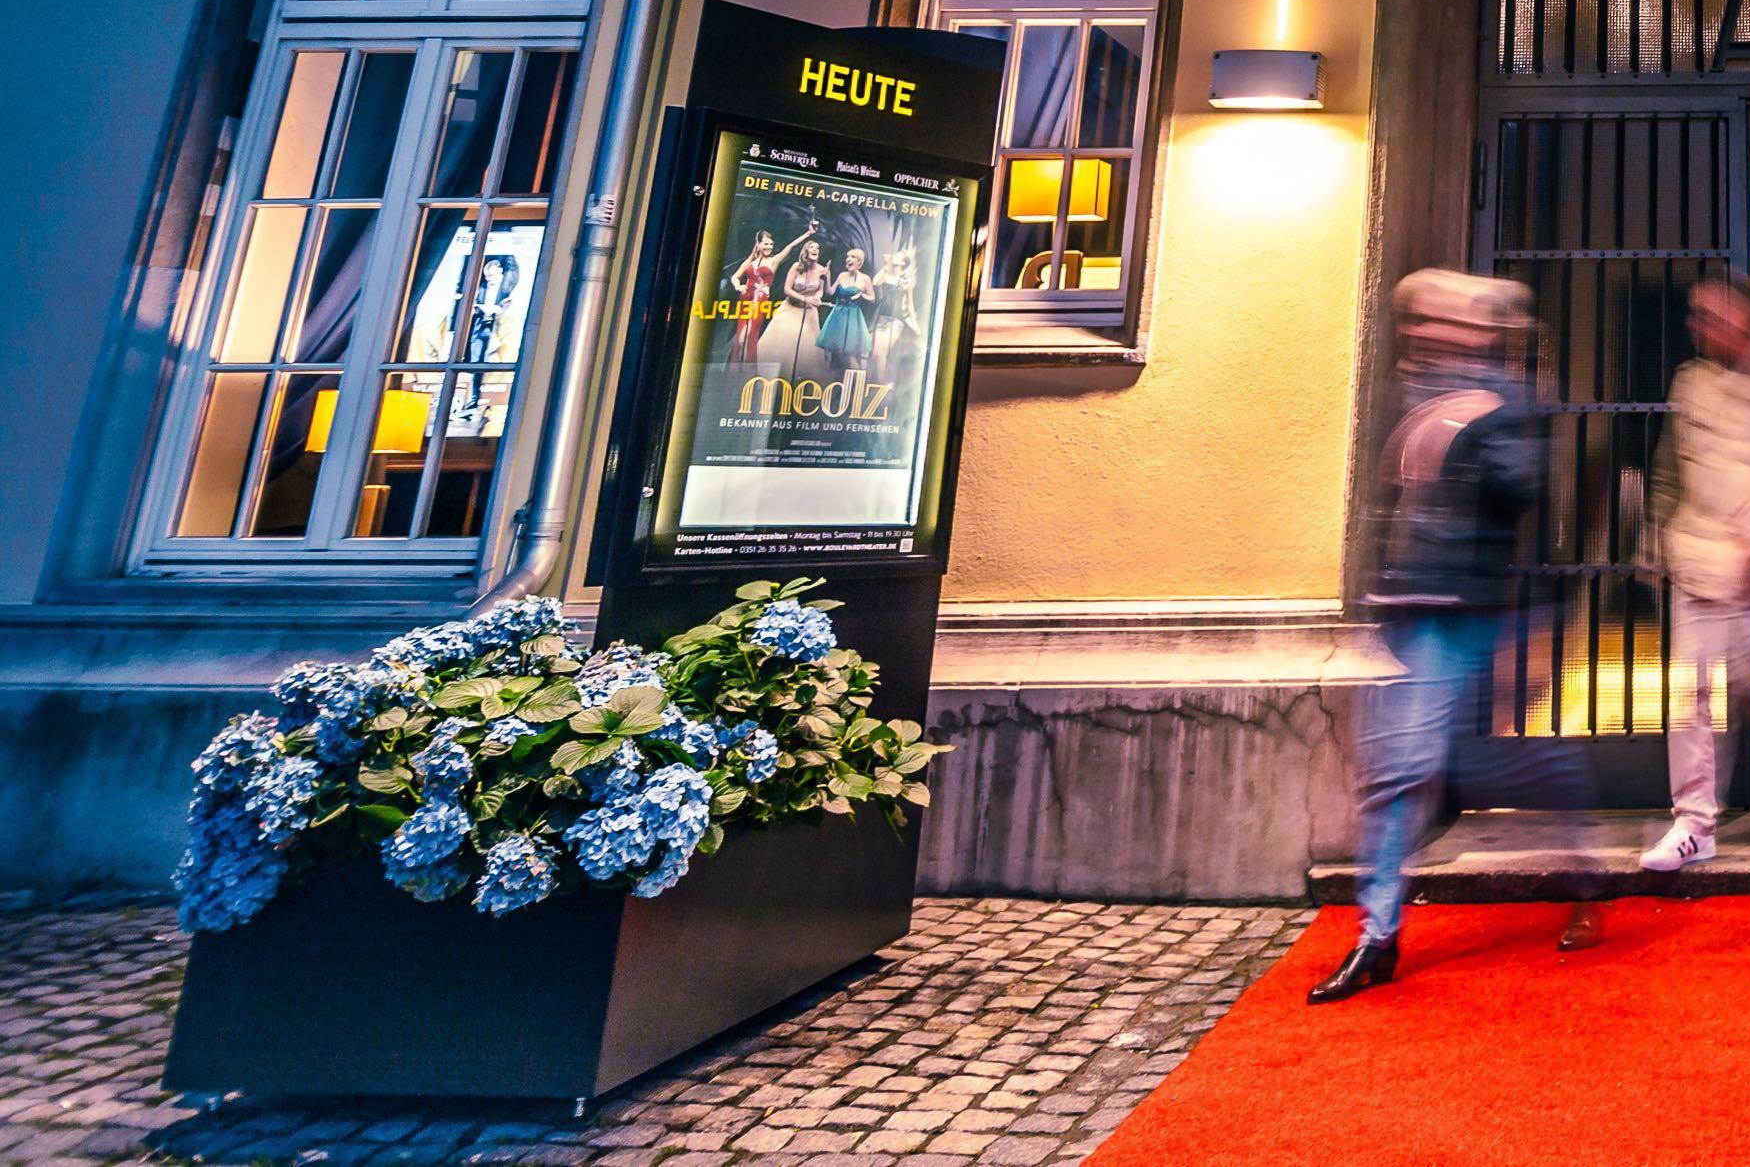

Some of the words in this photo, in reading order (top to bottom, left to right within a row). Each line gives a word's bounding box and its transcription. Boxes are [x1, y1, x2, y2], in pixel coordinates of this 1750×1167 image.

[799, 57, 916, 116] HEUTE
[894, 173, 939, 190] OPPACHER
[744, 176, 769, 189] DIE
[773, 181, 813, 197] NEUE
[816, 190, 897, 211] A-CAPPELLA
[901, 202, 939, 218] SHOW
[719, 417, 769, 429] BEKANNT
[772, 420, 792, 430] AUS
[795, 421, 819, 430] FILM
[822, 422, 843, 432] UND
[846, 423, 900, 434] FERNSEHEN
[676, 533, 705, 542] Unsere
[794, 532, 821, 540] Montag
[834, 531, 862, 539] Samstag
[674, 546, 733, 555] Karten-Hotline
